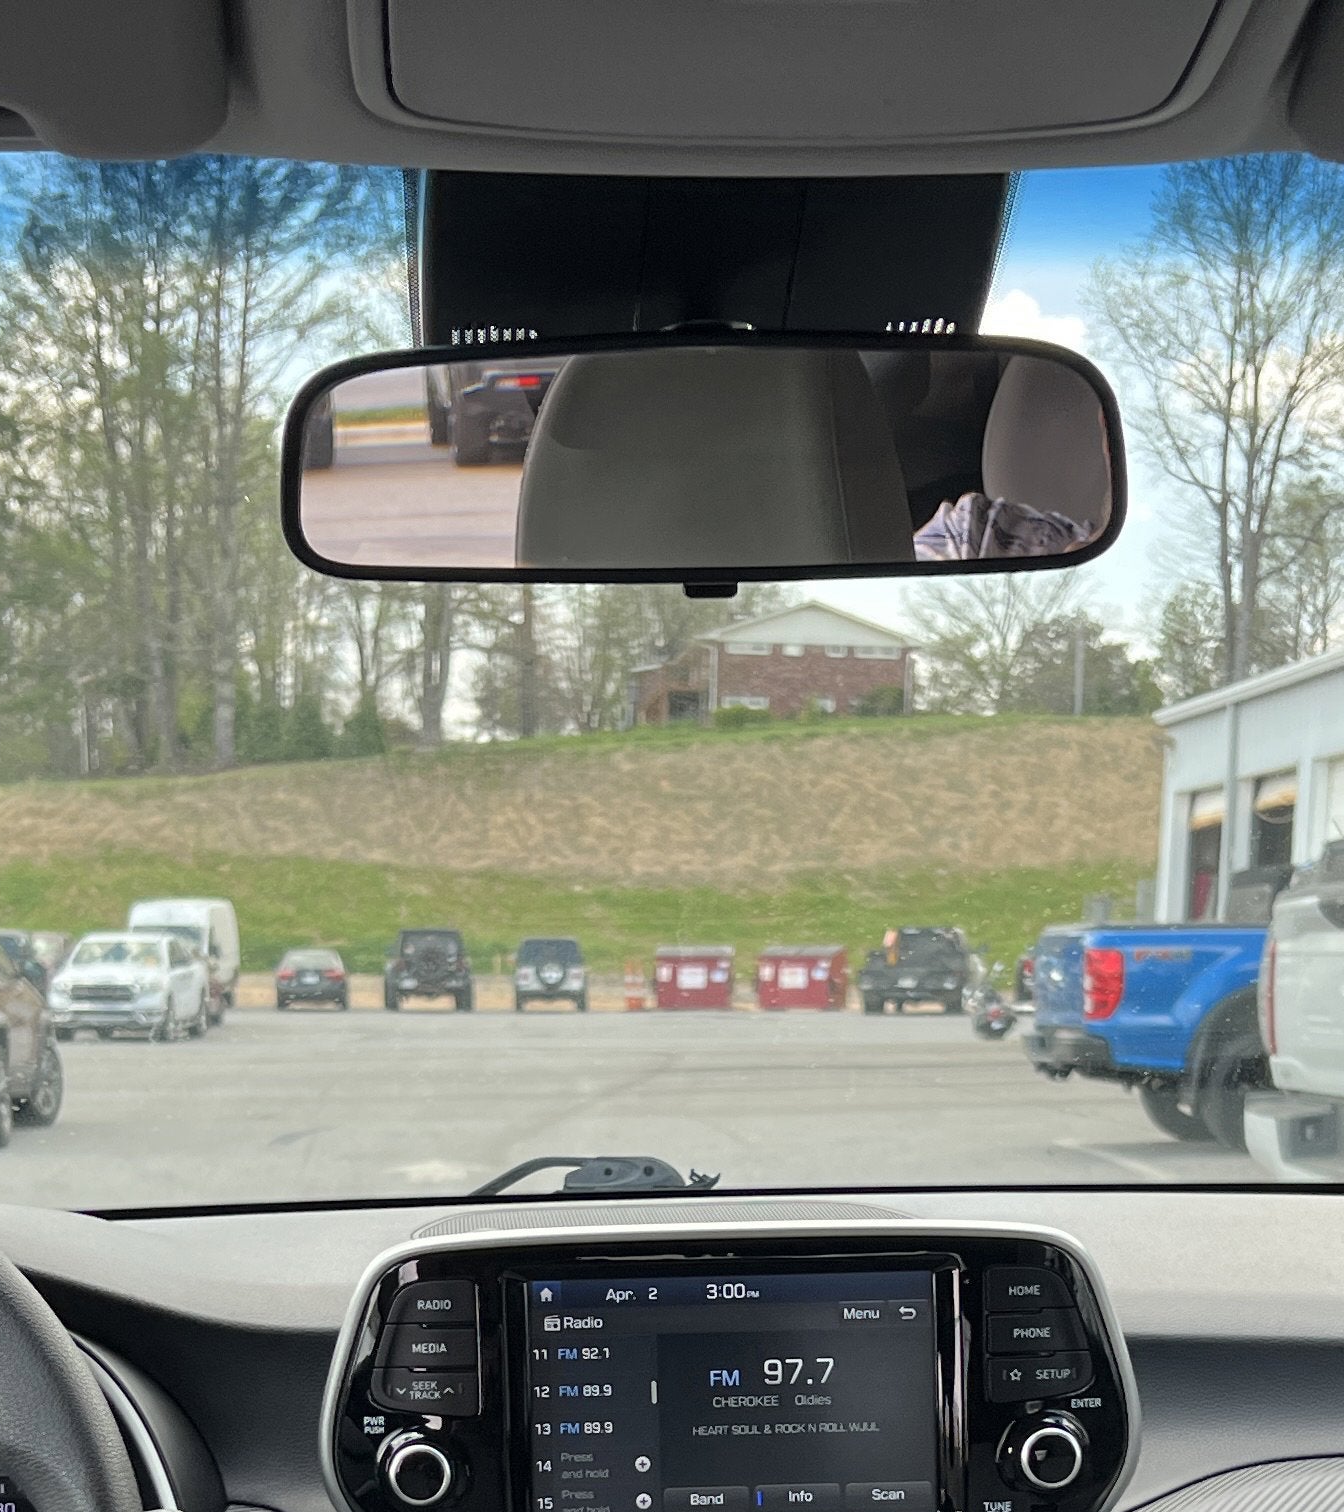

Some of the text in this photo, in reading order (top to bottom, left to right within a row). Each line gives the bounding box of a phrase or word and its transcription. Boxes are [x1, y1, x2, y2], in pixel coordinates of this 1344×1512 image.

[605, 1287, 658, 1303] Apr. 2
[1008, 1285, 1040, 1296] HOME
[417, 1299, 452, 1310] RADIO
[844, 1308, 880, 1319] Menu
[564, 1317, 603, 1329] Radio
[1013, 1327, 1051, 1338] PHONE
[411, 1343, 447, 1353] MEDIA
[533, 1348, 610, 1360] 11 FM 92.1
[710, 1358, 834, 1386] FM 97.7
[1036, 1369, 1071, 1379] SETUP
[412, 1381, 438, 1391] SEEK
[534, 1385, 612, 1397] 12 FM 89.9
[409, 1390, 441, 1400] TRACK
[713, 1394, 831, 1408] CHEROKEE Oldies
[1070, 1398, 1101, 1408] ENTER
[363, 1416, 385, 1426] PWR
[535, 1422, 613, 1435] 13 FM 89.9
[693, 1425, 728, 1436] HEART
[763, 1424, 772, 1434] &
[774, 1423, 806, 1434] ROCK
[536, 1453, 594, 1472] 14 Press
[561, 1469, 609, 1479] and hold
[537, 1490, 594, 1510] 15 Press
[690, 1493, 723, 1506] Band
[788, 1491, 813, 1503] Info
[871, 1489, 904, 1501] Scan
[983, 1501, 1012, 1512] TUNE
